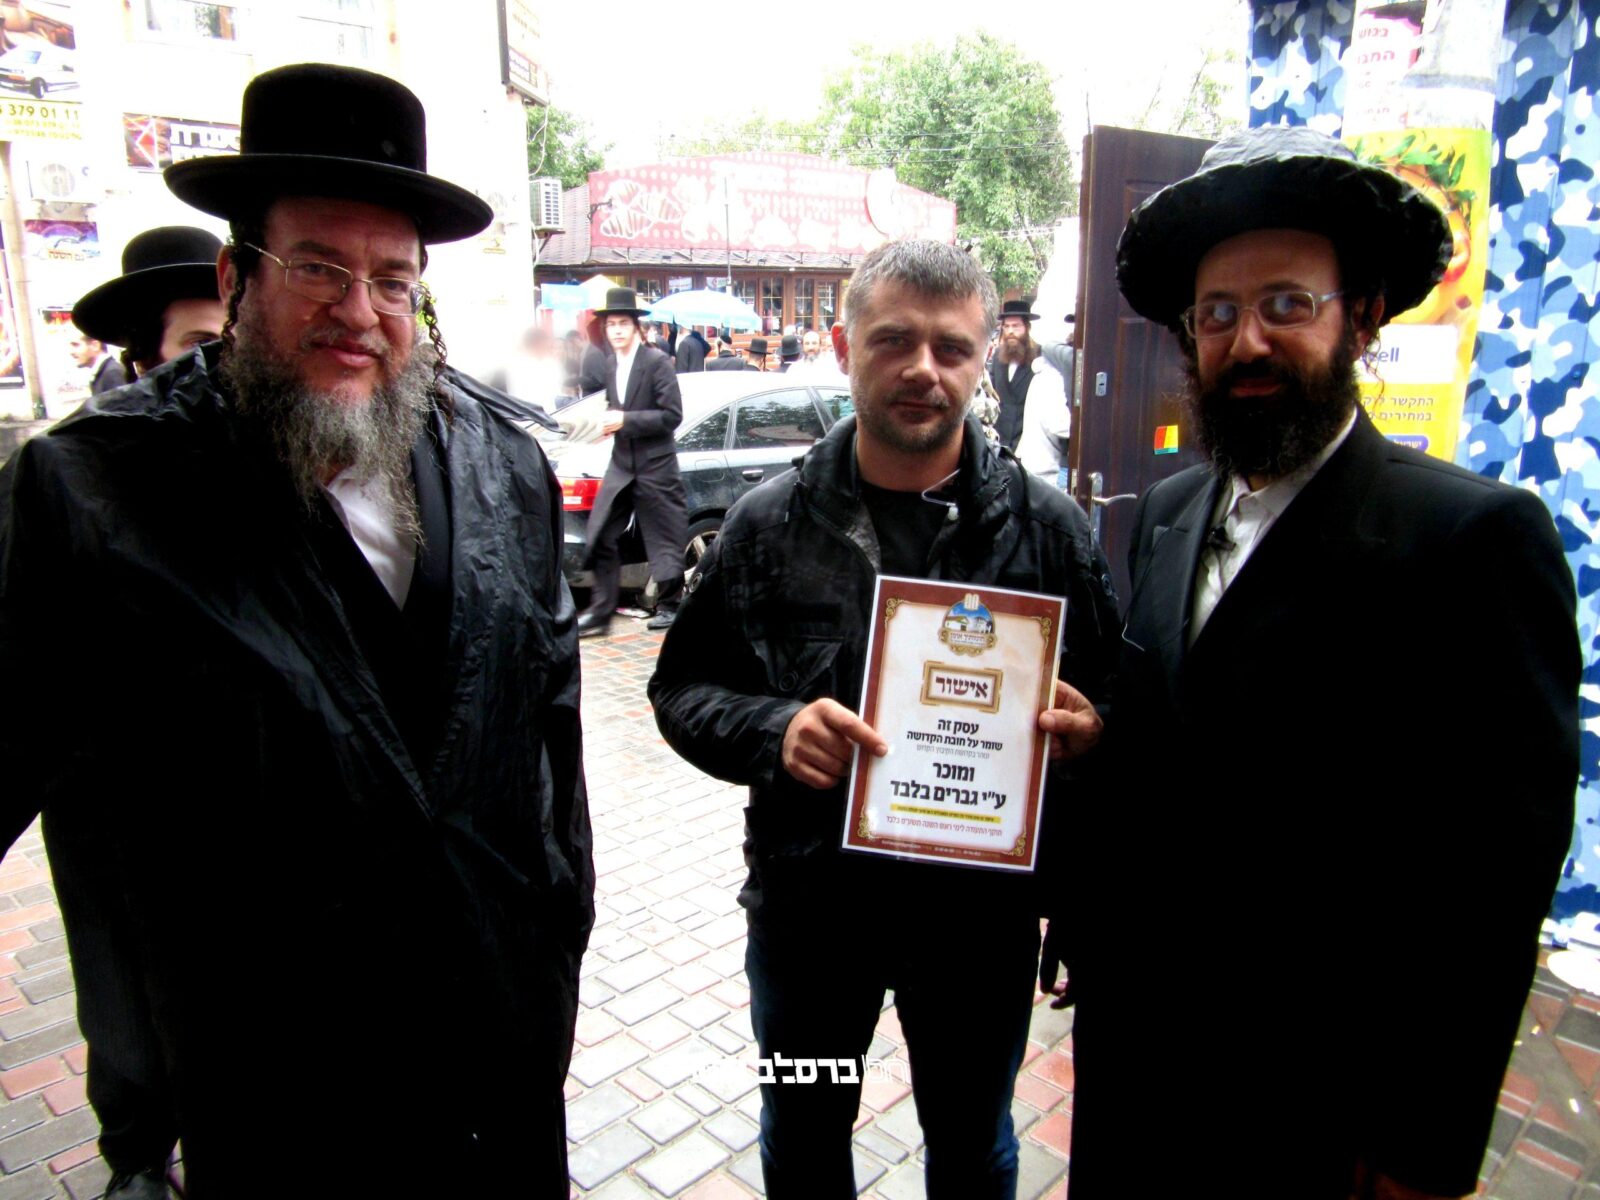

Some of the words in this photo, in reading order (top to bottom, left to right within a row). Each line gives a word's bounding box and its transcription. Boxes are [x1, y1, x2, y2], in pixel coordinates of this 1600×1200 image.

[8, 103, 35, 116] 379
[1391, 397, 1434, 408] התקשר
[935, 676, 989, 698] אישור
[938, 719, 952, 731] זה
[953, 720, 979, 735] עסק
[907, 731, 943, 744] הקדושה
[944, 735, 966, 747] חובת
[967, 736, 979, 748] על
[981, 741, 1003, 751] שומר
[933, 762, 975, 782] ומוכר
[890, 780, 930, 800] בלבד
[933, 785, 978, 806] גברים
